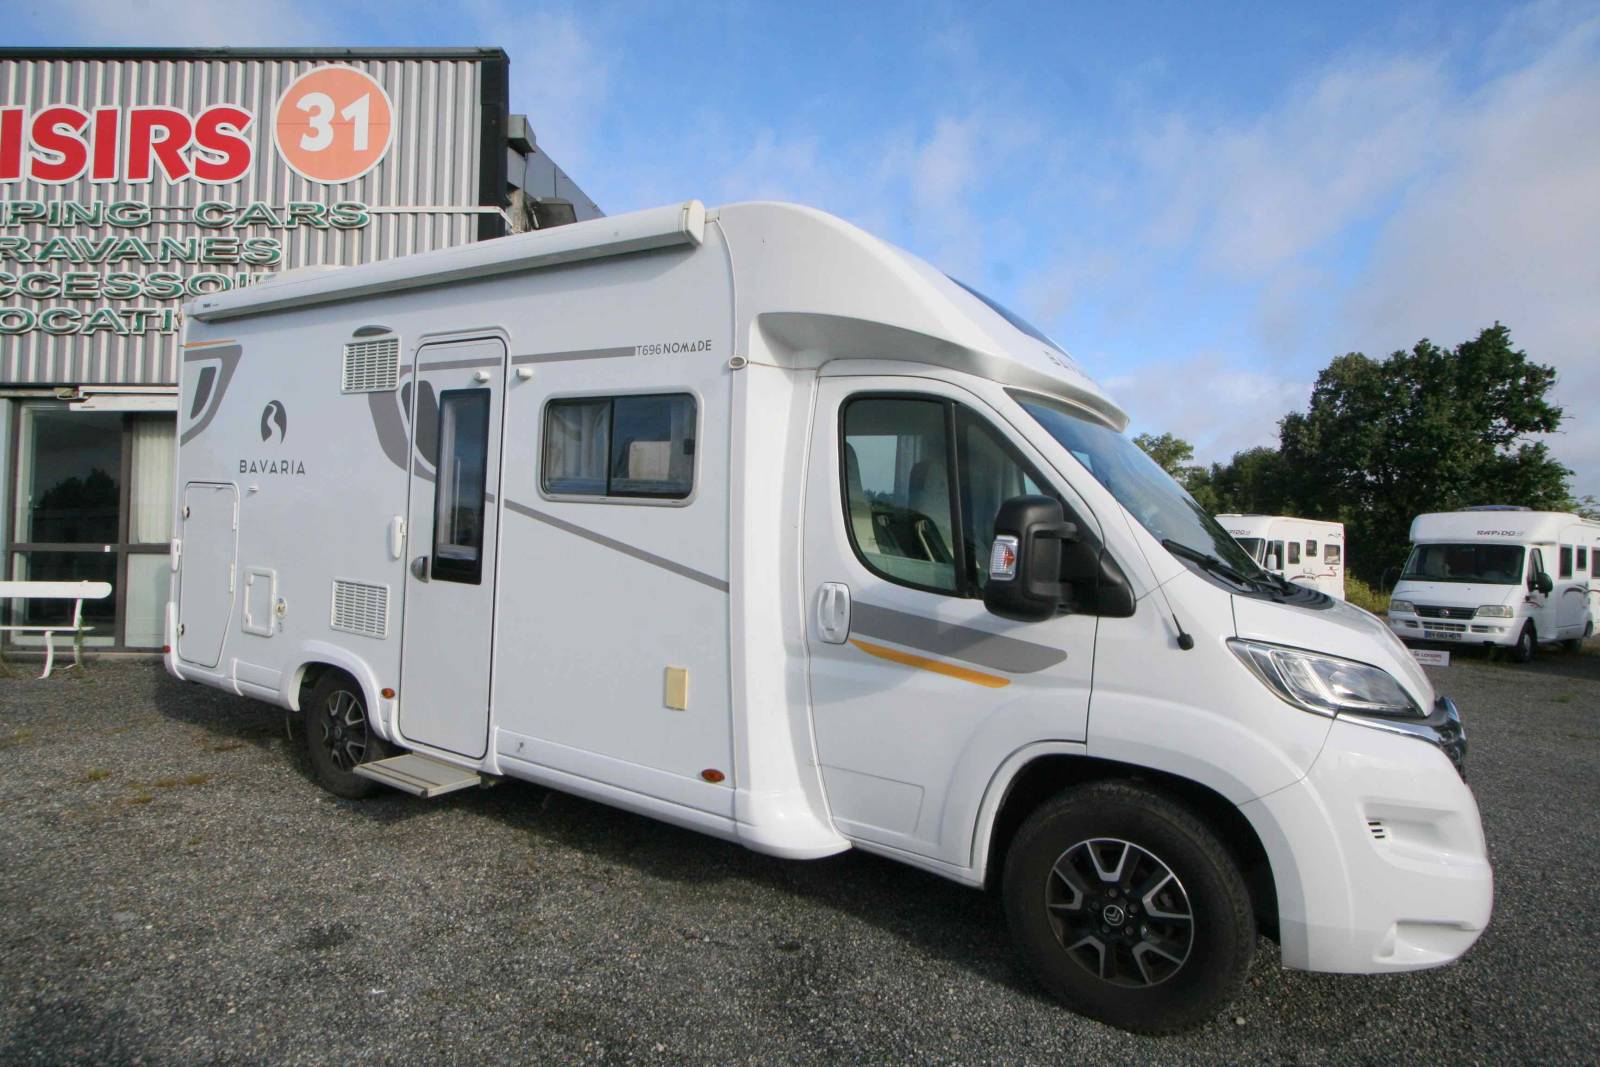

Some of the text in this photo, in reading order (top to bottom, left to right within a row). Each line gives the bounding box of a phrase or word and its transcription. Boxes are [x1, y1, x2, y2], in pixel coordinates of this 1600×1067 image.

[0, 92, 370, 182] ISIRS 31
[0, 201, 369, 228] PING CARS
[0, 236, 281, 265] RAVANES
[637, 339, 712, 356] T696 NOMADE
[239, 459, 305, 475] BAVARIA
